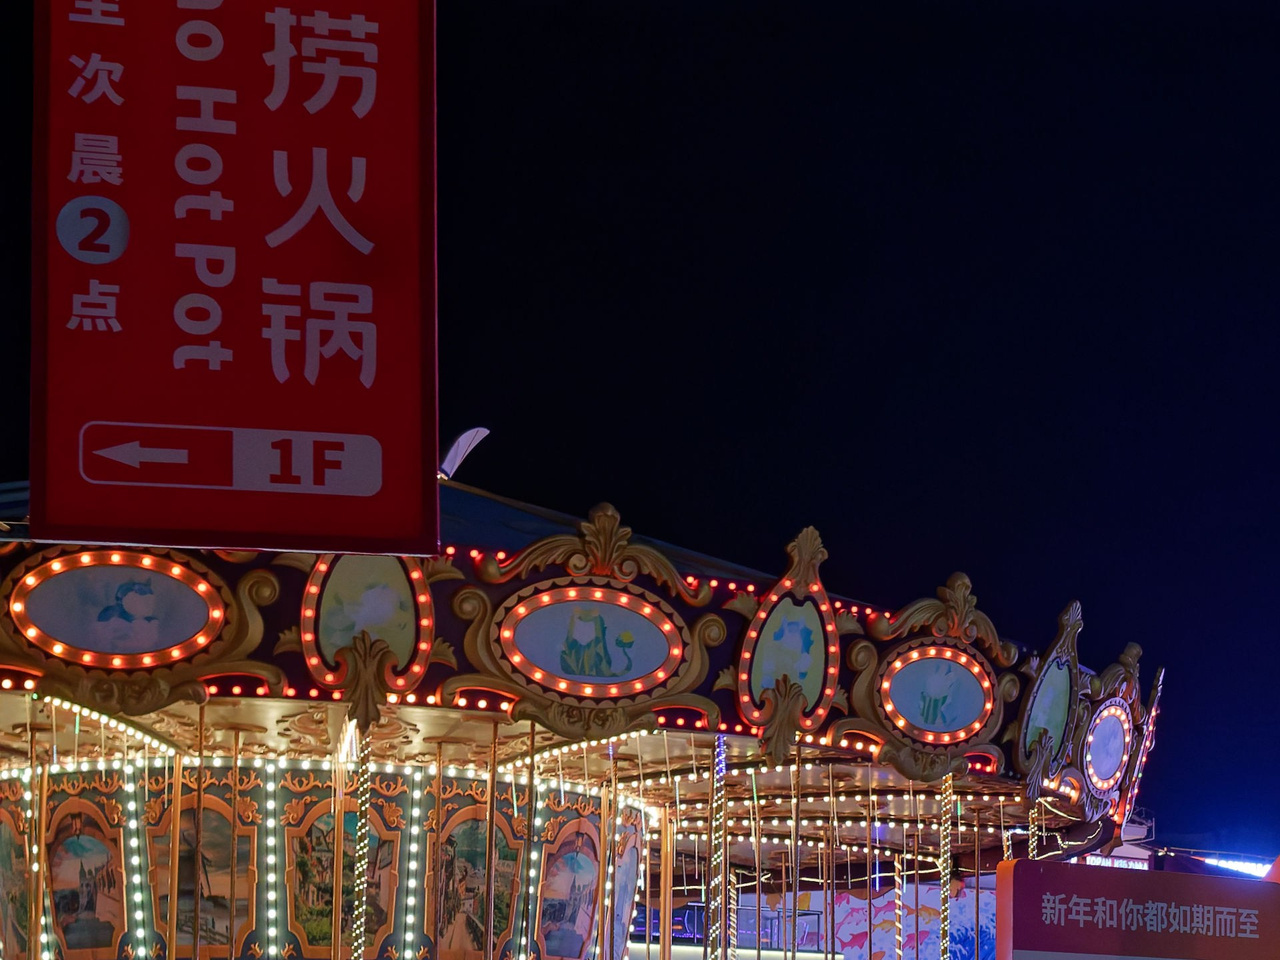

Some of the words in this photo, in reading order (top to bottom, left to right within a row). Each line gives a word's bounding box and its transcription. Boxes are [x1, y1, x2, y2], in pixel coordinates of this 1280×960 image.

[175, 0, 225, 61] o
[174, 85, 238, 221] Hot
[172, 243, 237, 372] Pot
[268, 437, 347, 487] 1F
[1040, 891, 1260, 939] 新年和你都如期而至
